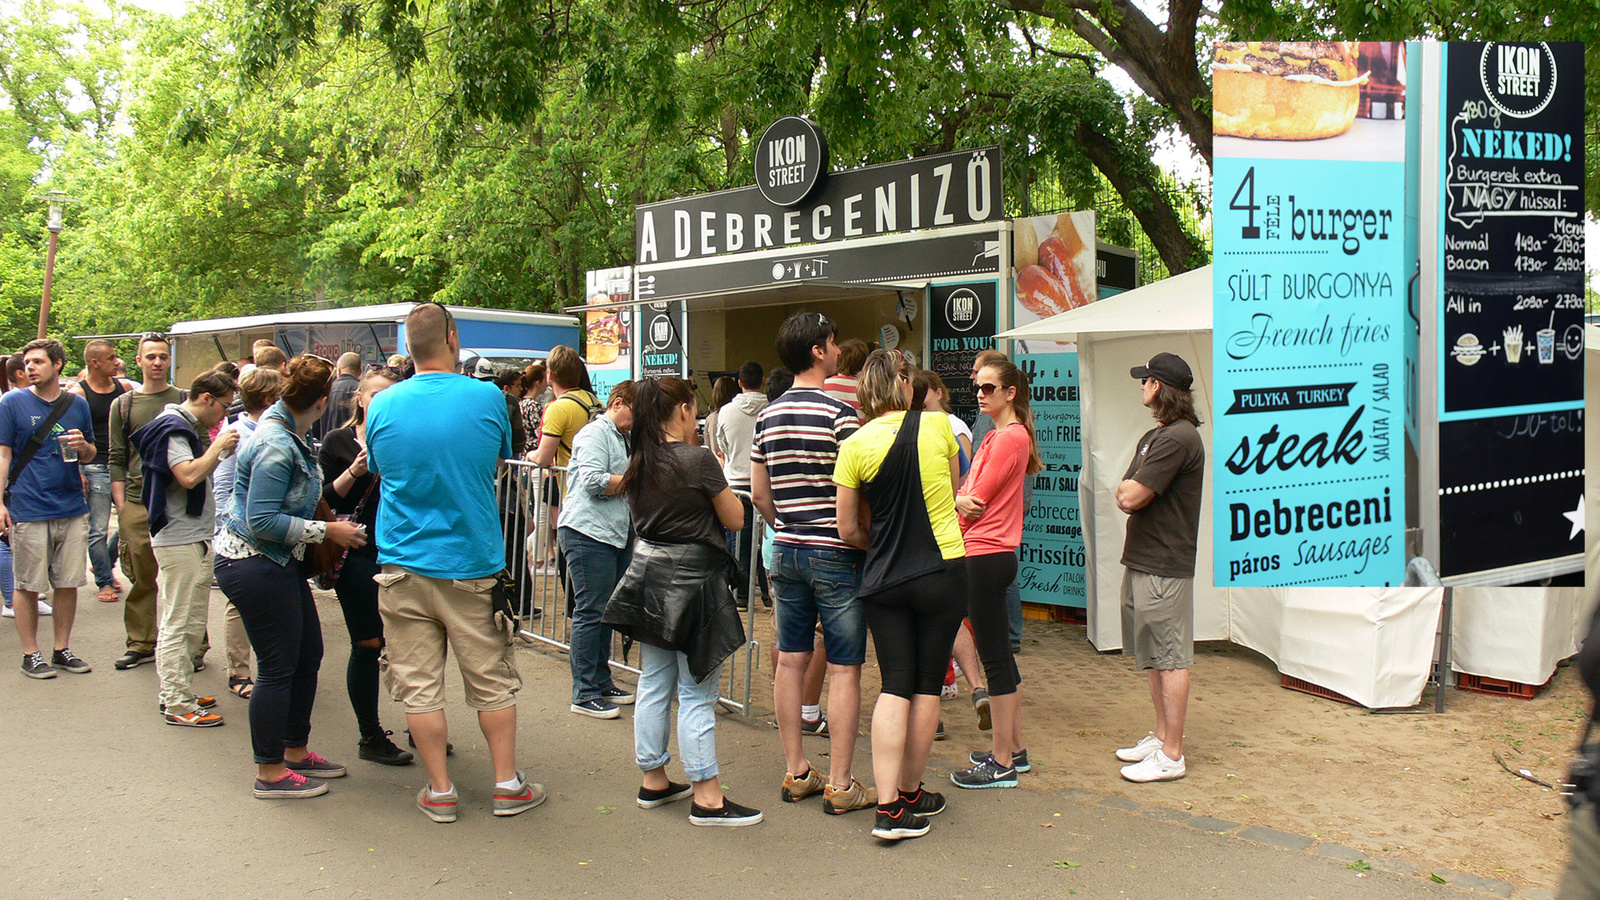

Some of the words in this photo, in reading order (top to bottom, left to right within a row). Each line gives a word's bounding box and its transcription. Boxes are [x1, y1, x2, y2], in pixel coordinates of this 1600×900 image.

[1498, 44, 1540, 76] IKON
[1498, 77, 1540, 97] STREET
[1463, 100, 1488, 119] 180
[768, 134, 806, 168] IKON
[1461, 128, 1572, 162] NEKED!
[768, 163, 806, 189] STREET
[1457, 164, 1520, 188] Burgerek
[1524, 167, 1562, 184] extra
[1229, 166, 1260, 239] 4
[1462, 185, 1518, 210] NAGY
[1520, 189, 1567, 210] hússal:
[1264, 195, 1280, 240] FÉLE
[1288, 195, 1392, 255] burger
[640, 210, 659, 263] A
[1445, 232, 1489, 250] Normál
[1446, 254, 1489, 271] Bacon
[1228, 269, 1271, 301] SÜLT
[1283, 272, 1392, 299] BURGONYA
[952, 297, 973, 311] IKON
[952, 311, 973, 321] STREET
[1446, 294, 1465, 314] All
[1468, 297, 1482, 313] in
[933, 338, 960, 351] FOR
[962, 336, 993, 351] YOU!
[1226, 312, 1333, 360] French
[1340, 313, 1390, 357] fries
[645, 353, 678, 366] NEKED!
[1021, 359, 1037, 384] 4
[1373, 363, 1390, 402] SALAD
[1241, 391, 1290, 408] PULYKA
[1296, 388, 1345, 405] TURKEY
[1225, 404, 1367, 475] steak
[1370, 418, 1390, 462] SALÁTA
[1046, 451, 1067, 461] Turkey
[1229, 486, 1391, 541] Debreceni
[1018, 542, 1086, 568] Frissítő
[1229, 552, 1280, 581] páros
[1293, 535, 1392, 575] Sausages
[1018, 566, 1063, 593] Fresh
[1063, 572, 1085, 584] ITALOK
[1063, 585, 1085, 597] DRINKS
